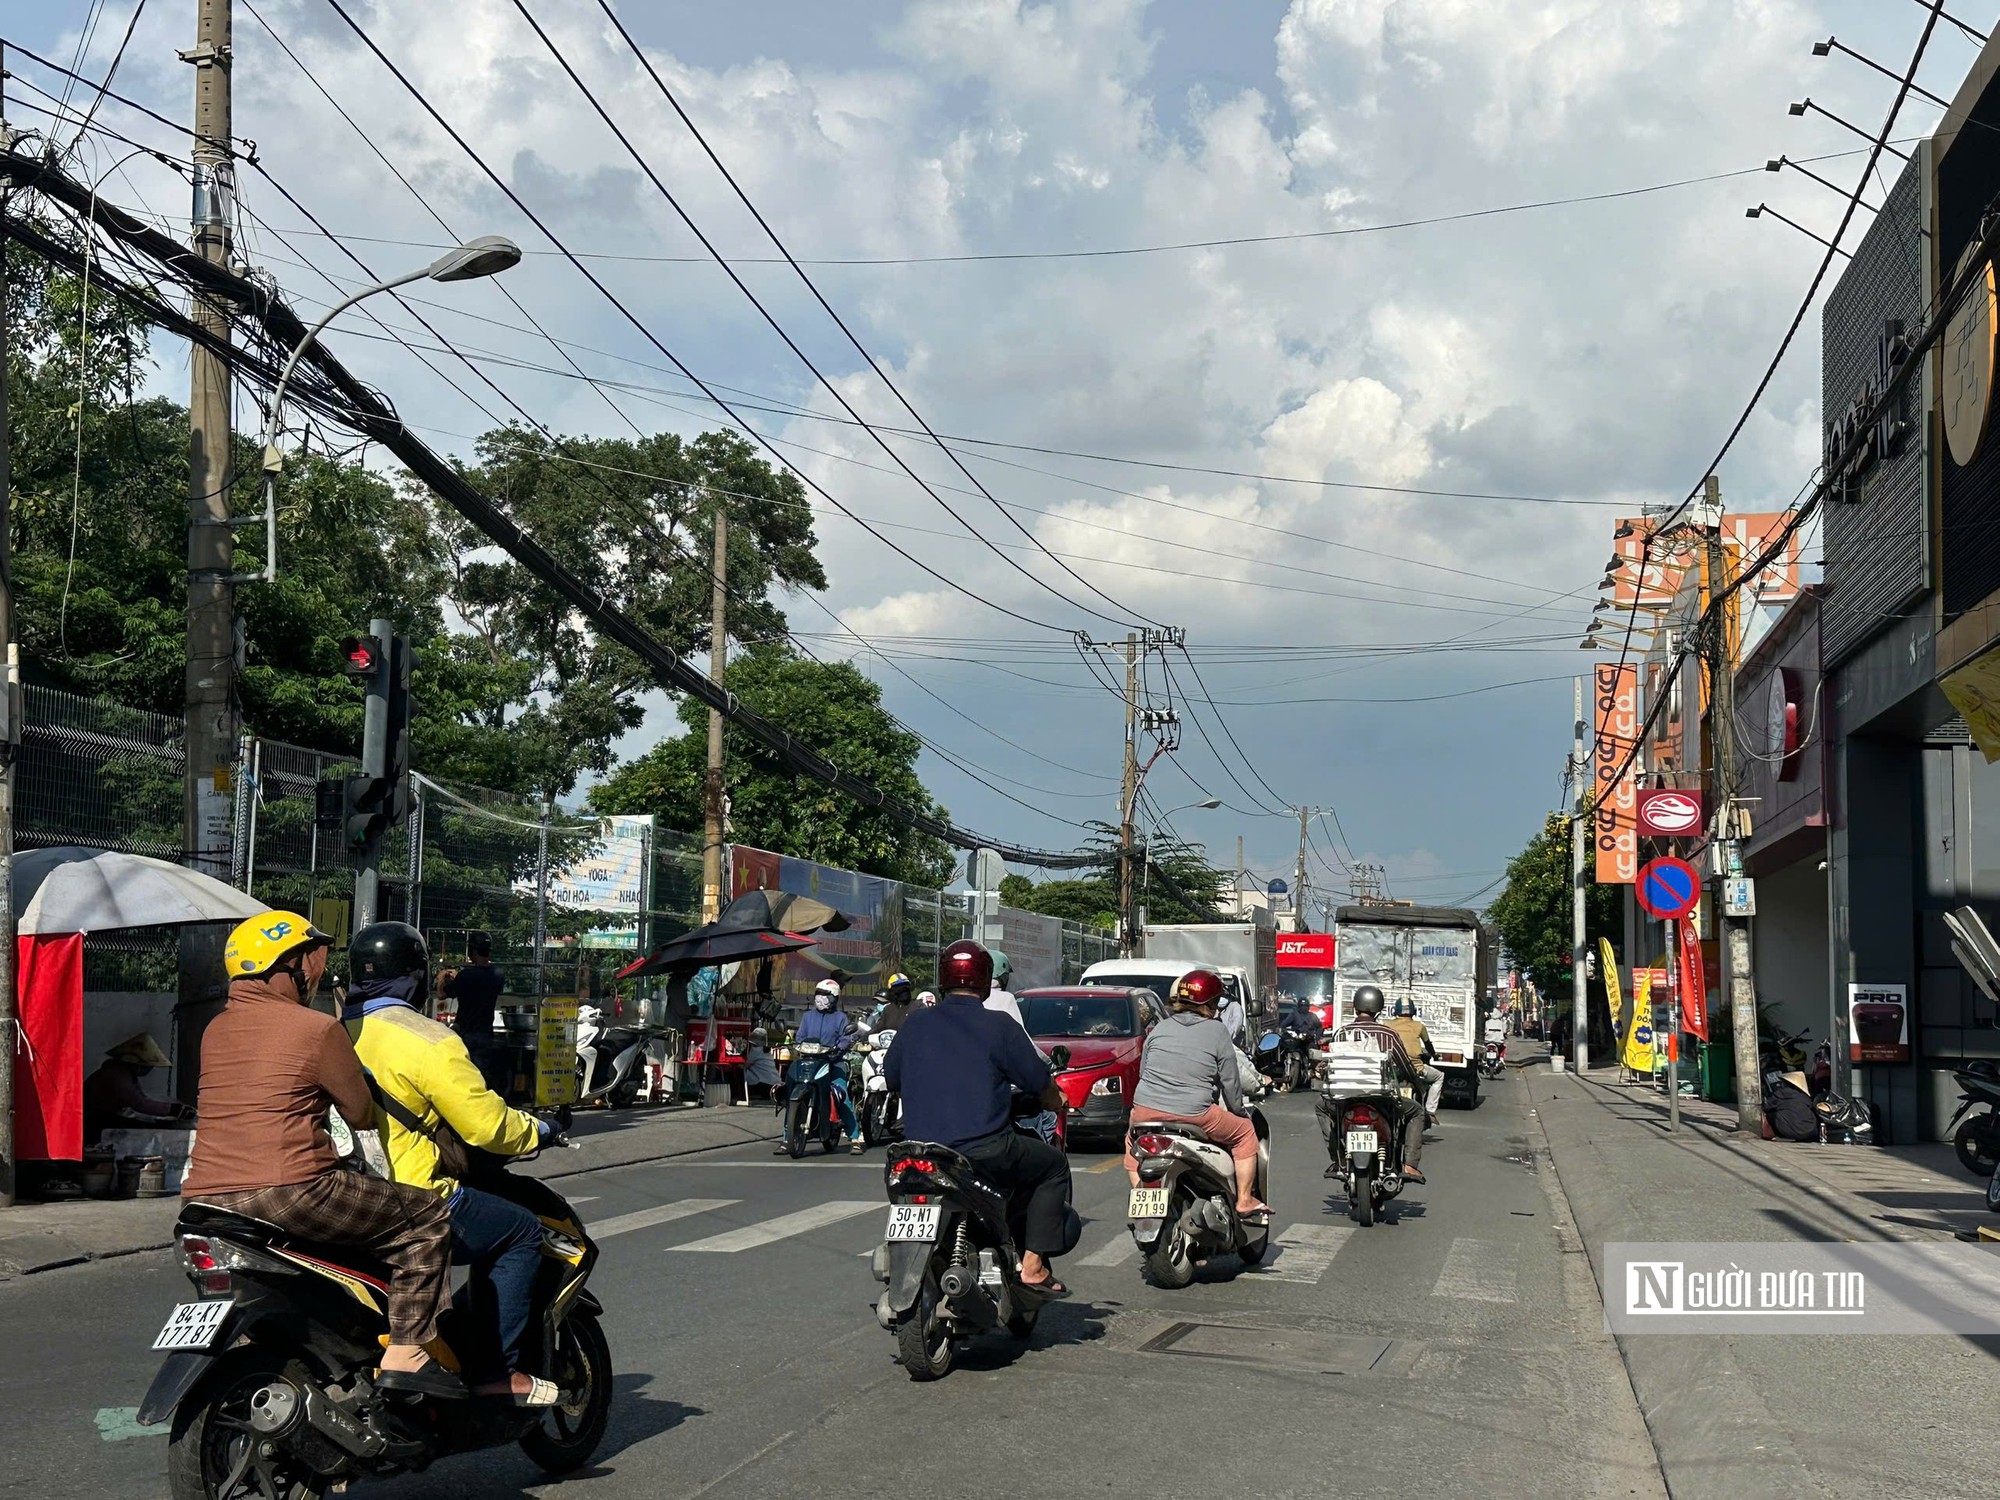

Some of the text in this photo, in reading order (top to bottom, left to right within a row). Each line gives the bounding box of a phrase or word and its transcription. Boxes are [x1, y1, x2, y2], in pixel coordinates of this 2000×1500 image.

[588, 869, 608, 881] YOGA
[260, 921, 292, 941] be
[1276, 941, 1307, 954] J&T
[1853, 993, 1902, 1003] PRO
[1135, 1190, 1162, 1203] 59-N1
[896, 1207, 932, 1223] 50-N1
[1131, 1203, 1165, 1216] 871.99
[888, 1223, 935, 1238] 078.32
[175, 1303, 223, 1324] 84-K1
[157, 1323, 218, 1347] 177.87
